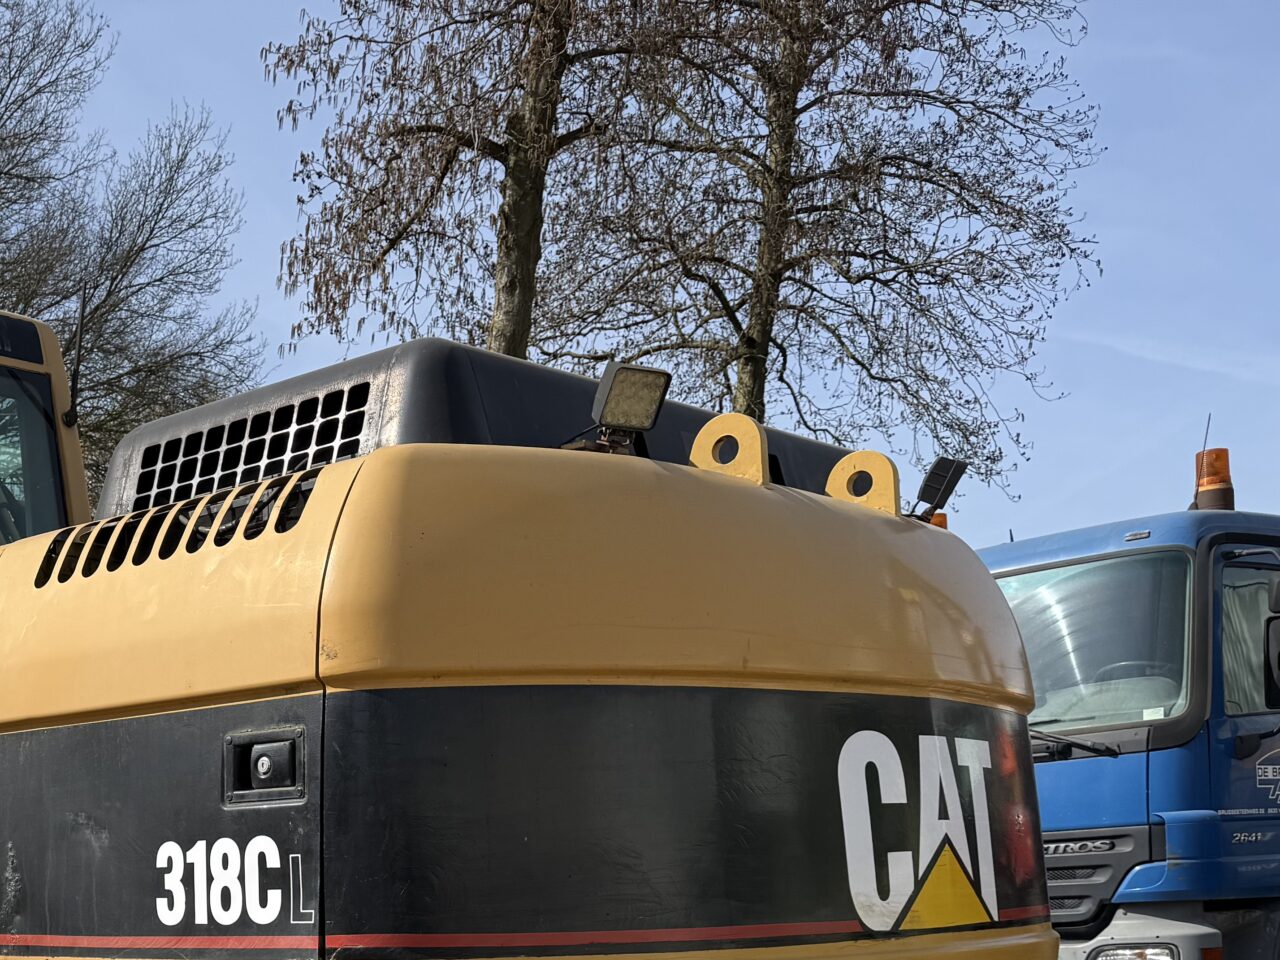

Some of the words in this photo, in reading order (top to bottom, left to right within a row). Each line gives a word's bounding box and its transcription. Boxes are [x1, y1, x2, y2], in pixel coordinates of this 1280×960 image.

[837, 729, 999, 931] CAT
[1043, 840, 1111, 855] TROS
[1232, 832, 1262, 844] 2641
[155, 834, 282, 926] 318C
